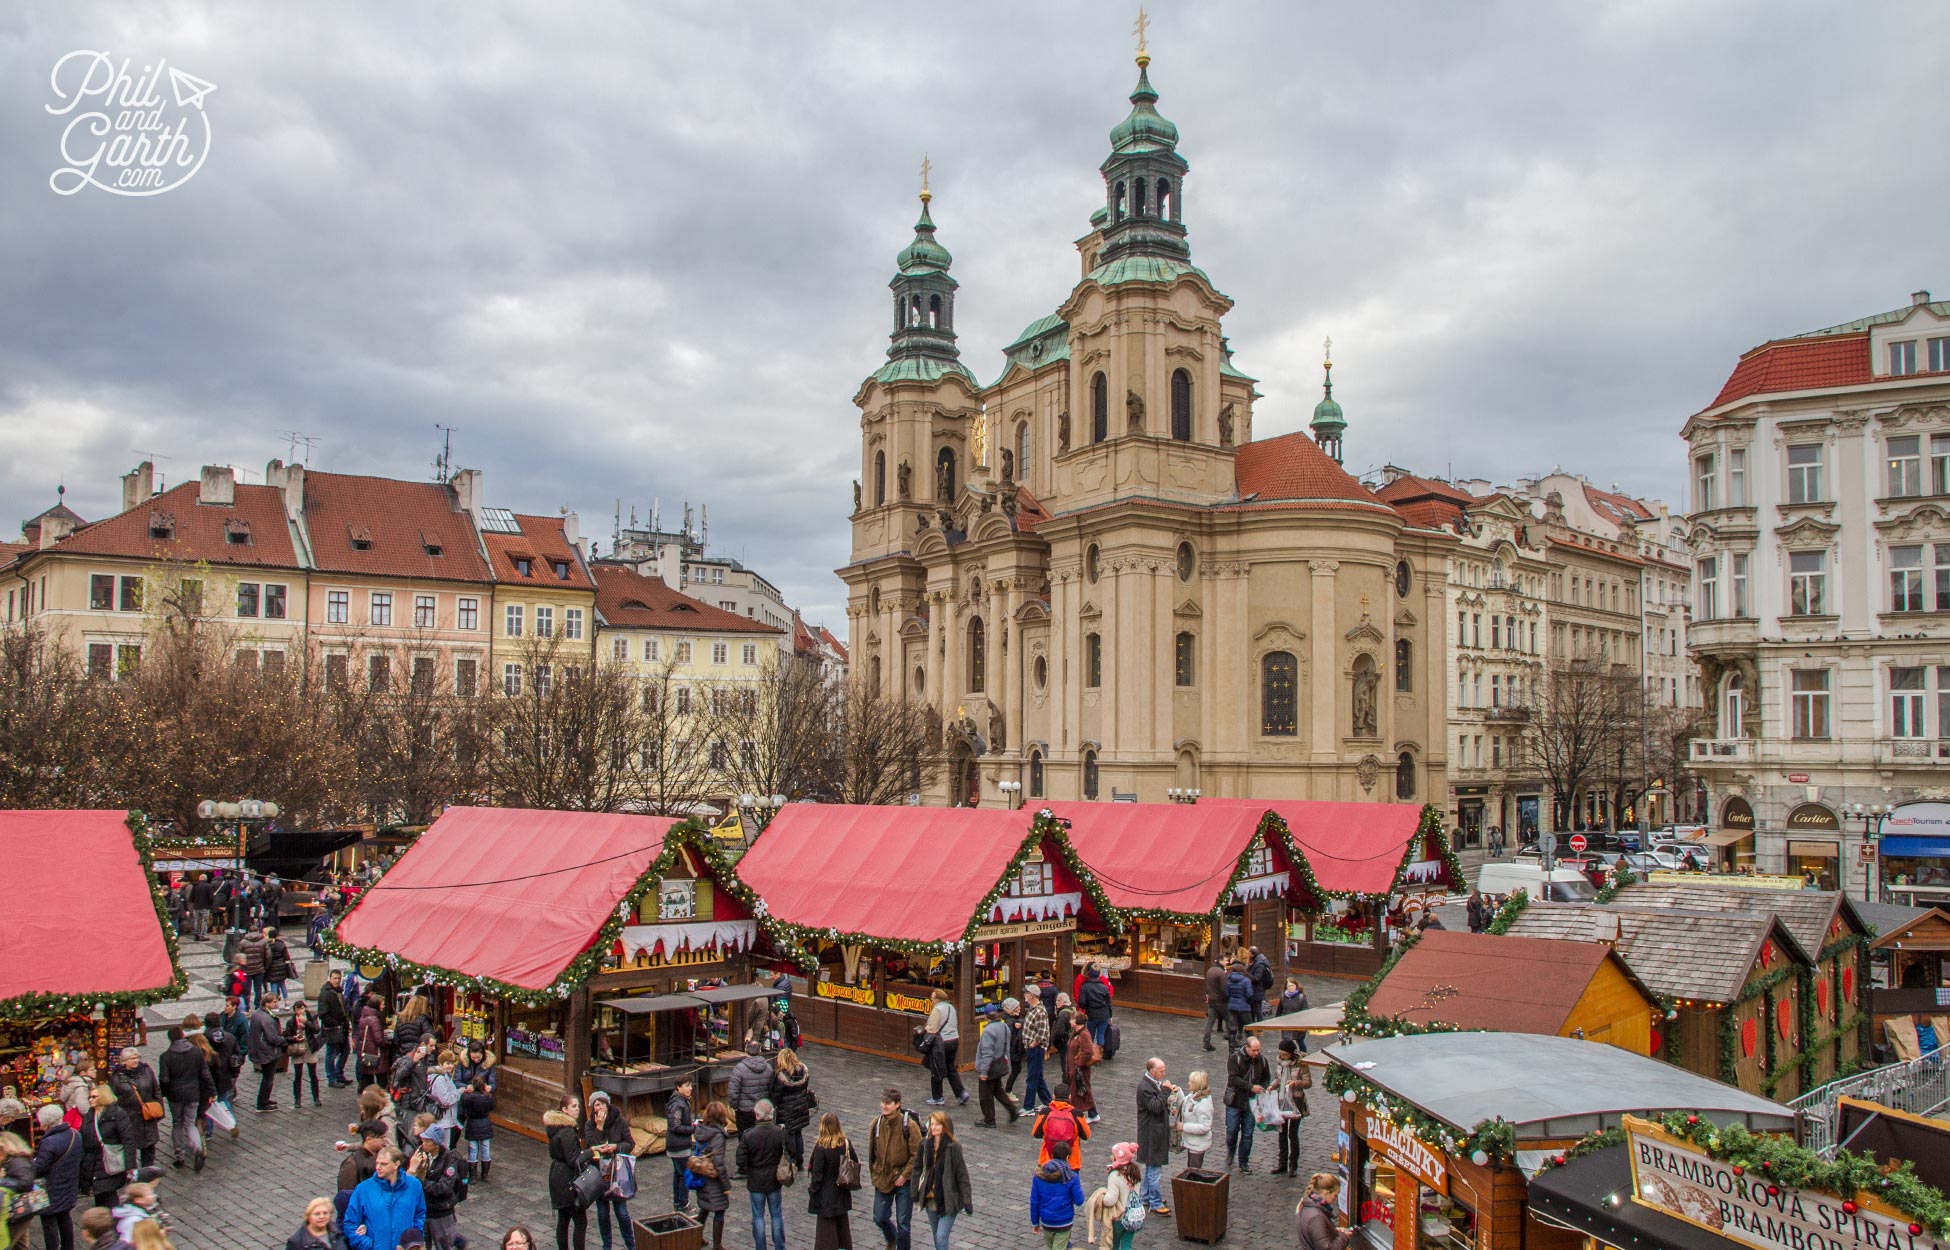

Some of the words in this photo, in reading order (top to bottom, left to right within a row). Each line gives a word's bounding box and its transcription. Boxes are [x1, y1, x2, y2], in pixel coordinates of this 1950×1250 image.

[1728, 811, 1752, 823] Cartier
[1793, 813, 1832, 824] Cartier
[1890, 817, 1943, 825] CzechTourism
[826, 982, 852, 998] Maraca
[852, 987, 866, 1004] Dog
[895, 993, 924, 1010] Maraca
[1639, 1141, 1808, 1223] BRAMBOROVÁ
[1817, 1203, 1942, 1250] SPIRÁL
